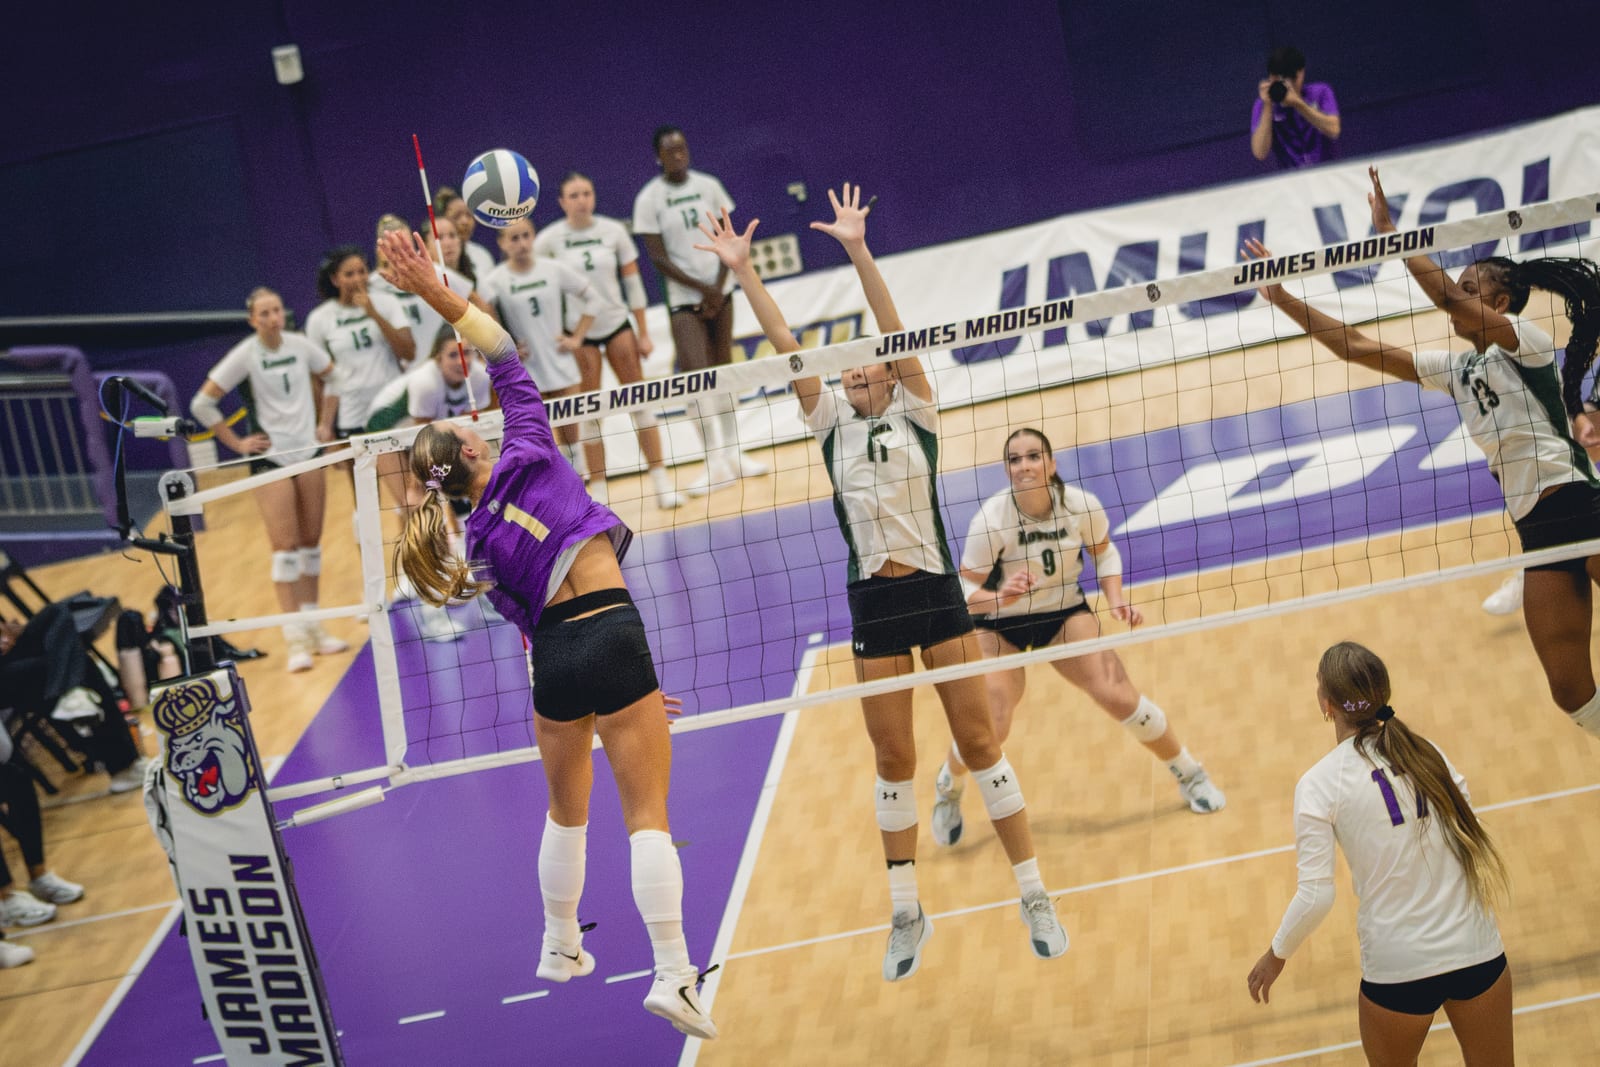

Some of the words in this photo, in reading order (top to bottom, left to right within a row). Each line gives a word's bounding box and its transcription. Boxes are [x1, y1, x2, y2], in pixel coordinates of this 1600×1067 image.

[488, 205, 530, 217] molten
[682, 208, 699, 230] 12
[583, 251, 594, 271] 2
[1234, 251, 1315, 285] JAMES
[1324, 226, 1434, 267] MADISON
[528, 296, 540, 317] 3
[951, 219, 1266, 365] JMU
[351, 327, 372, 350] 15
[876, 323, 956, 357] JAMES
[965, 299, 1074, 339] MADISON
[282, 373, 291, 395] 1
[542, 393, 601, 421] MES
[609, 370, 717, 409] MADISON
[503, 502, 551, 542] 1
[1041, 548, 1056, 577] 9
[189, 889, 271, 1054] JAMES
[230, 855, 325, 1067] MADISON
